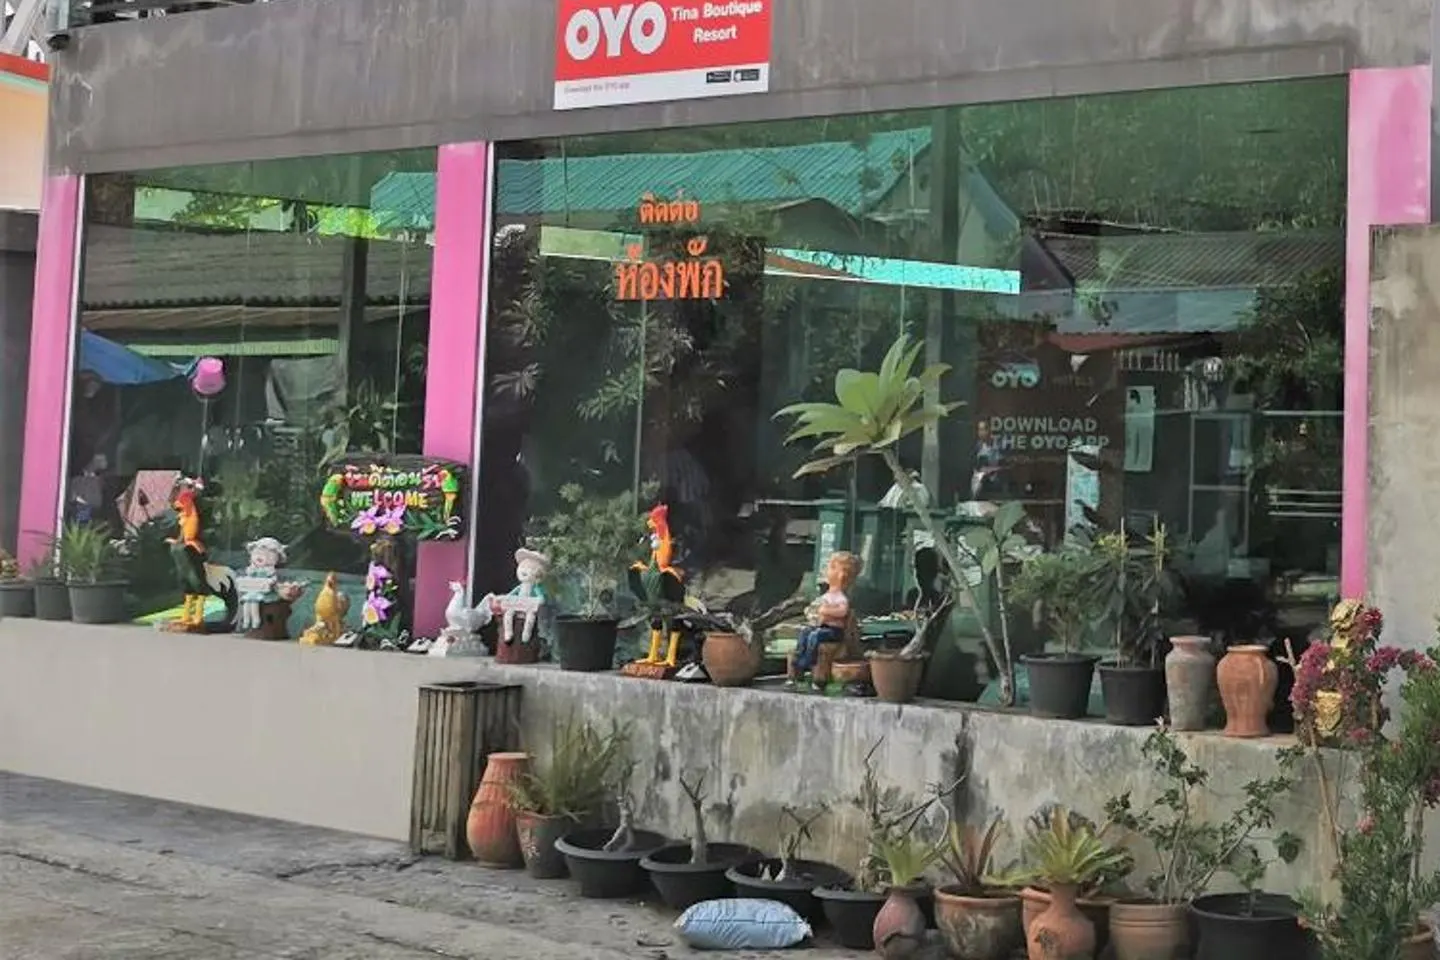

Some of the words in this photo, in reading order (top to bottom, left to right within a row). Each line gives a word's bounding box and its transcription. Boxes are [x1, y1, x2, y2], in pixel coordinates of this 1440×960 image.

[671, 7, 698, 21] Tina
[703, 0, 763, 19] Boutique
[565, 1, 668, 61] OYO
[693, 25, 737, 43] Resort
[639, 189, 699, 224] ติดต่อ
[615, 235, 725, 300] ห้องพัก
[991, 369, 1040, 388] OYO
[990, 416, 1098, 433] DOWNLOAD
[990, 434, 1028, 450] THE
[1031, 435, 1069, 450] OYO
[351, 489, 429, 510] WELCOME
